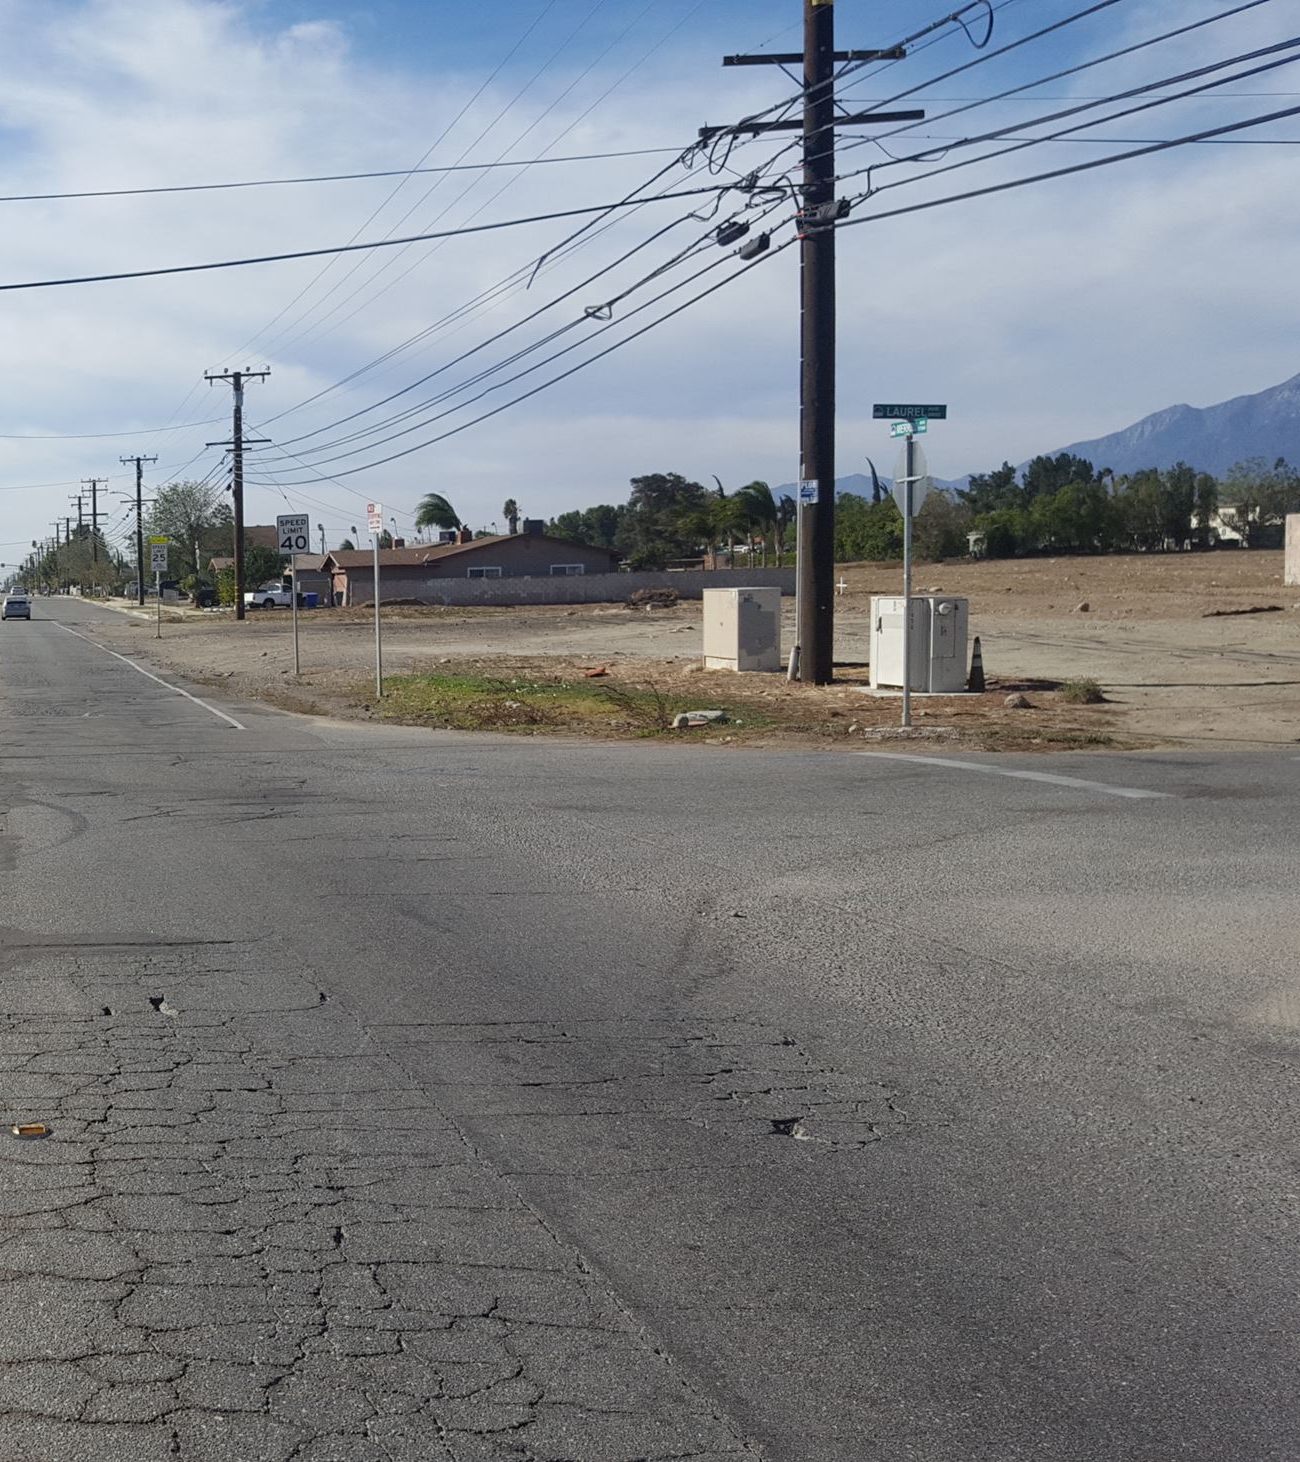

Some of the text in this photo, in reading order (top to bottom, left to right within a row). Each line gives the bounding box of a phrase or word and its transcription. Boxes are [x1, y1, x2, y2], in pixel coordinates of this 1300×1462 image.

[886, 406, 926, 417] LAUREL
[281, 535, 306, 550] 40
[152, 553, 166, 562] 25
